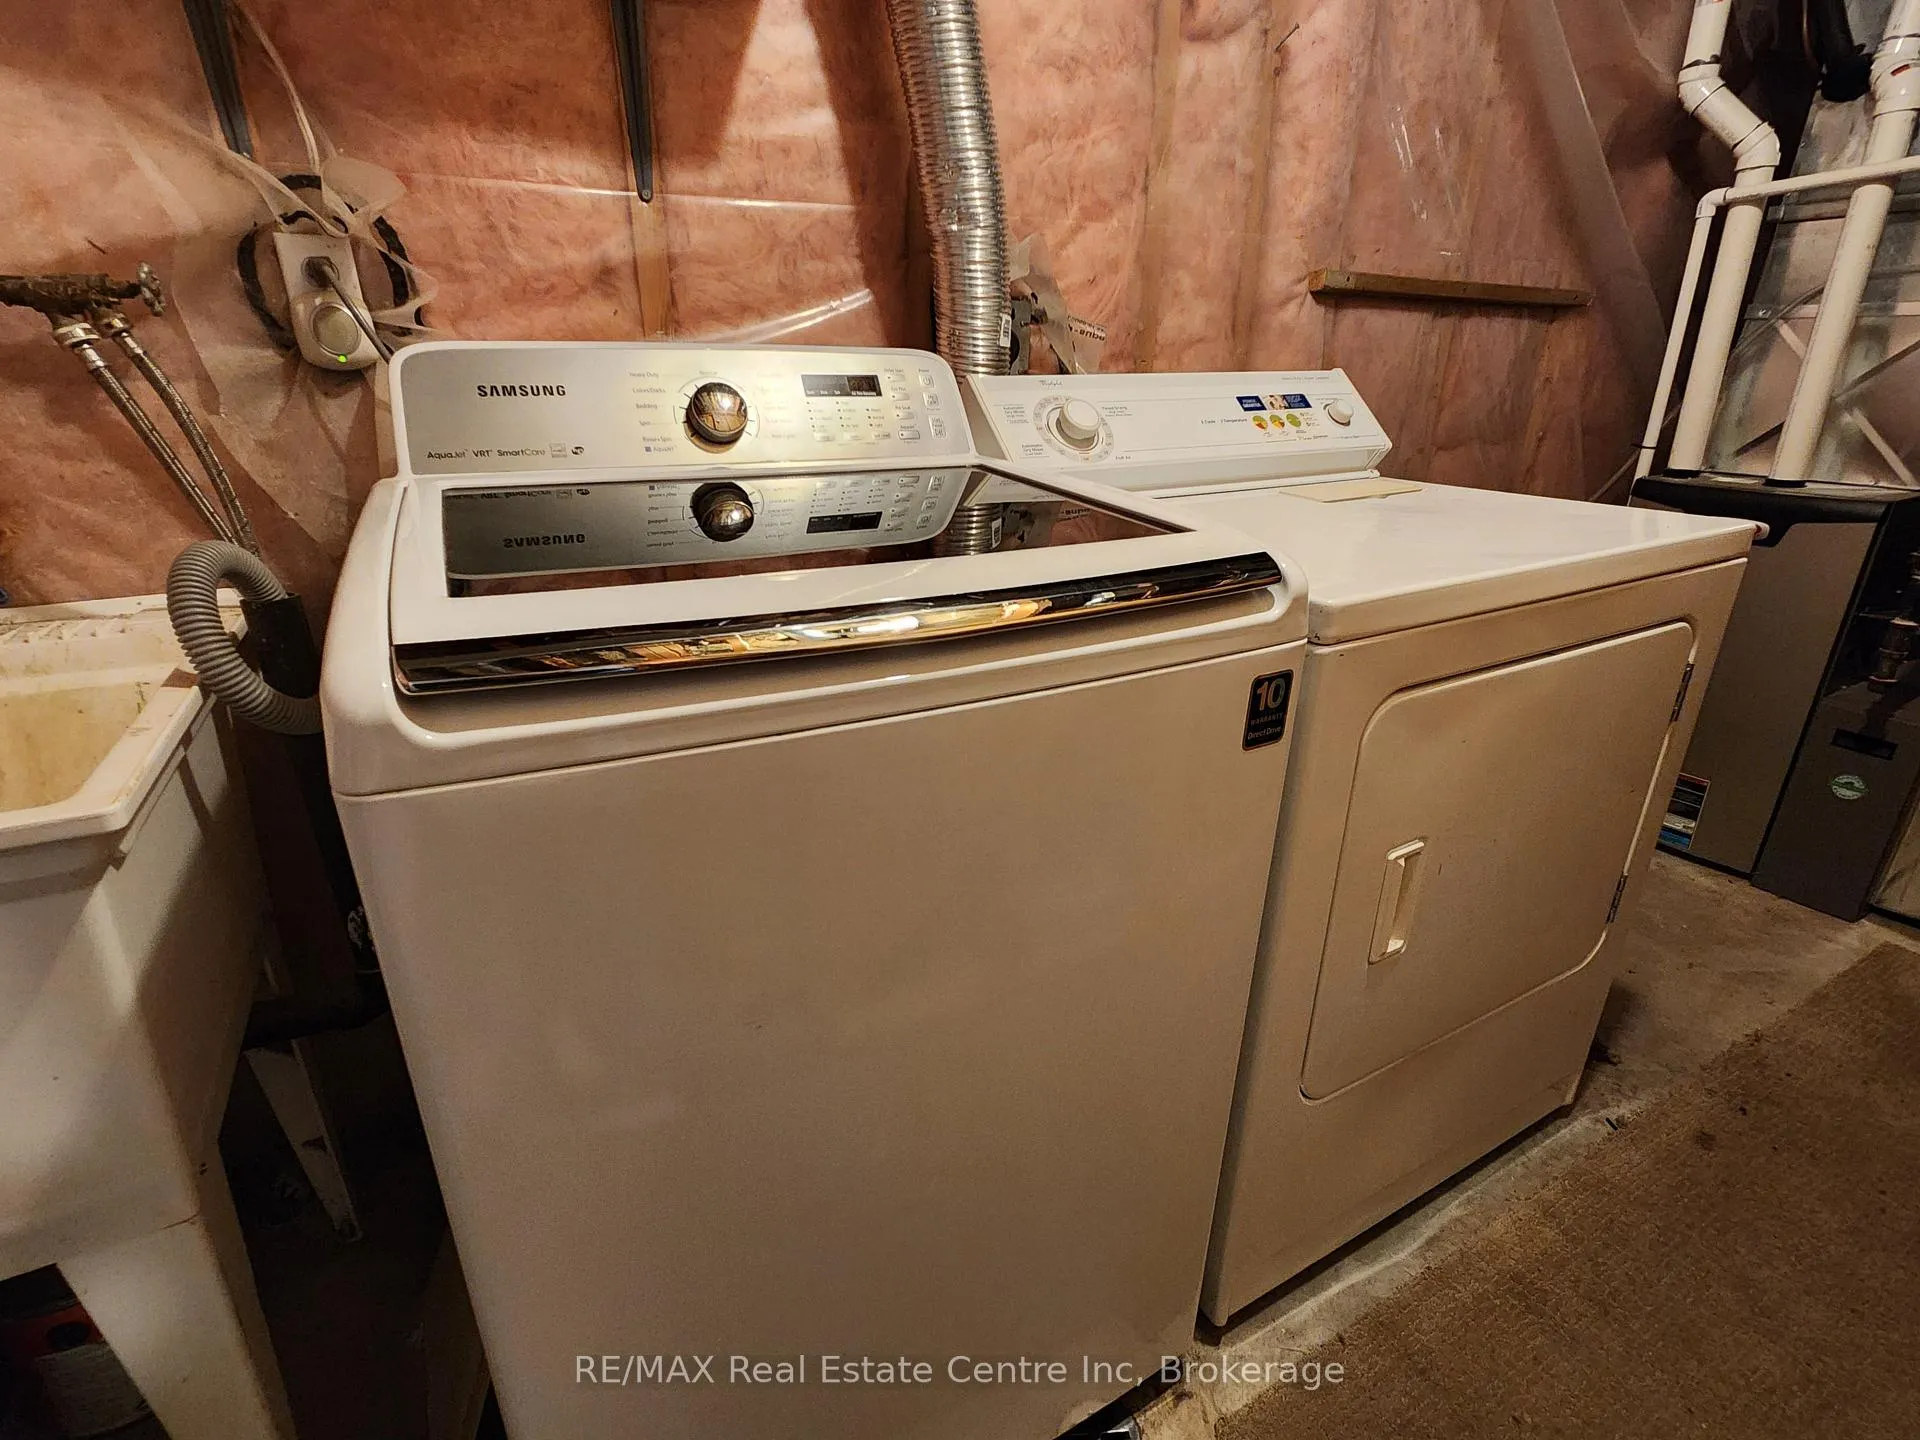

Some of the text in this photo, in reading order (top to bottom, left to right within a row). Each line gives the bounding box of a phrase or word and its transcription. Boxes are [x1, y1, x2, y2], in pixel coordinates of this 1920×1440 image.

[477, 385, 566, 397] SAMSUNG
[497, 449, 546, 457] SmartCare
[1257, 678, 1286, 711] 10
